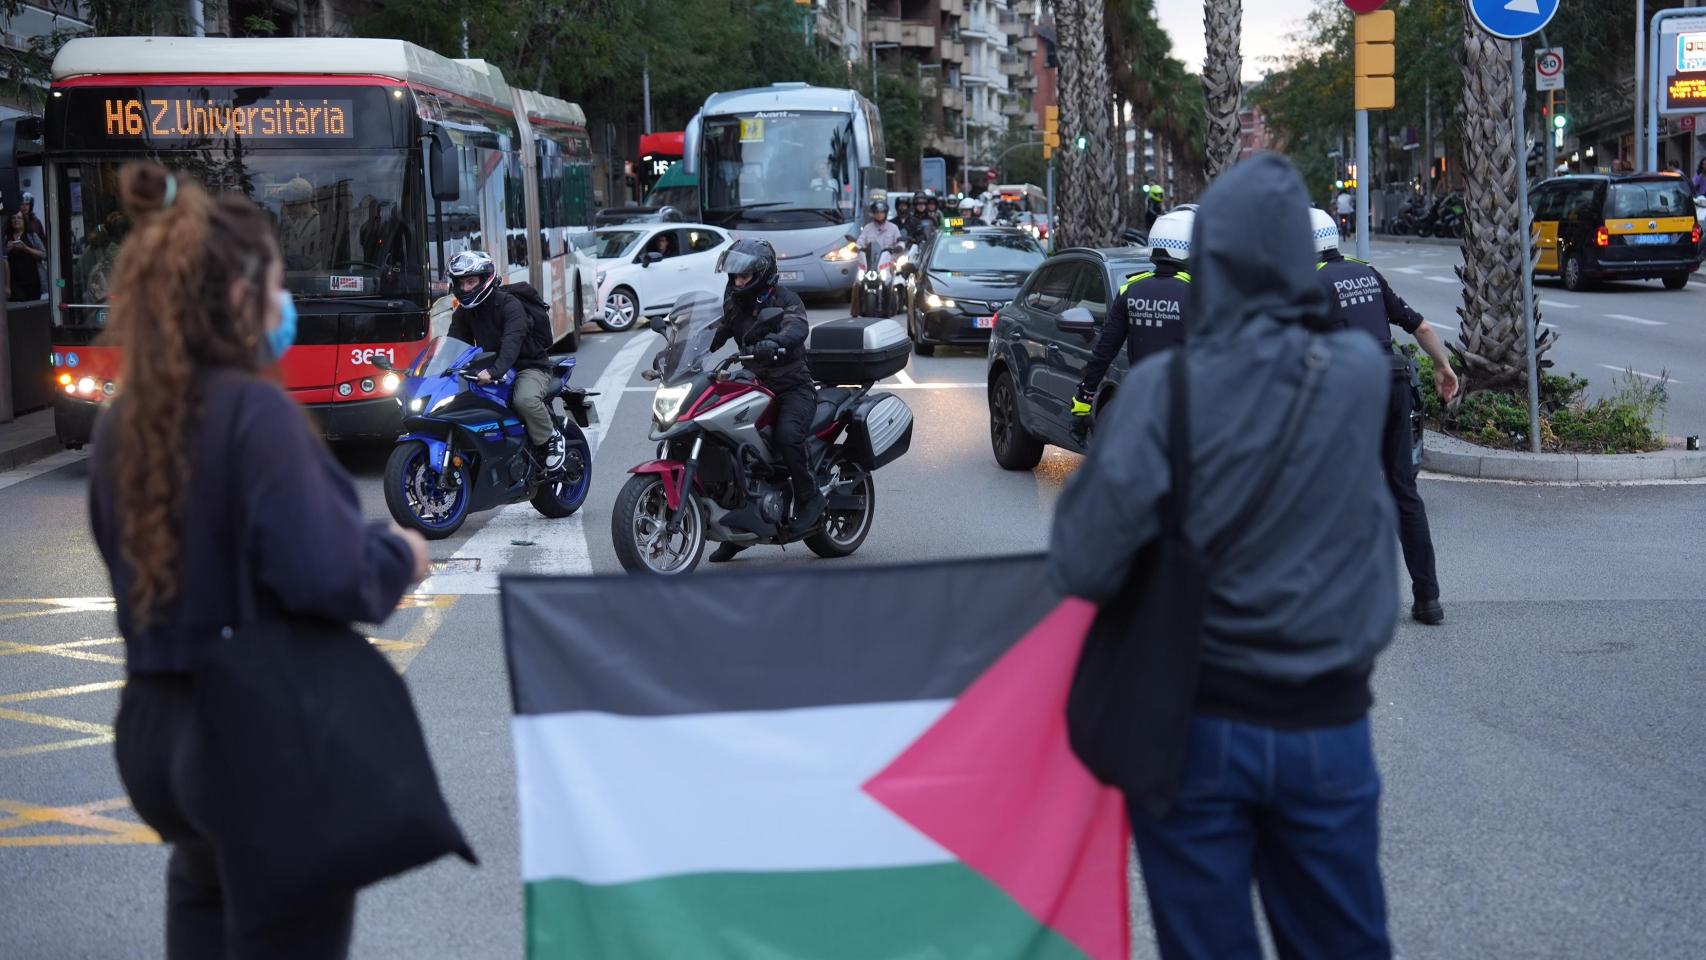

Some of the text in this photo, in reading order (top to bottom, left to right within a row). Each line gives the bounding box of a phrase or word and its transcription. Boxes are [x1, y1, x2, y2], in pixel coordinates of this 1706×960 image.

[105, 99, 344, 135] H6 Z.Universitària
[755, 111, 788, 119] Avant
[950, 218, 964, 226] TAXI
[1334, 276, 1379, 293] POLICIA
[1127, 298, 1180, 313] POLICIA
[1154, 312, 1180, 320] Urbana
